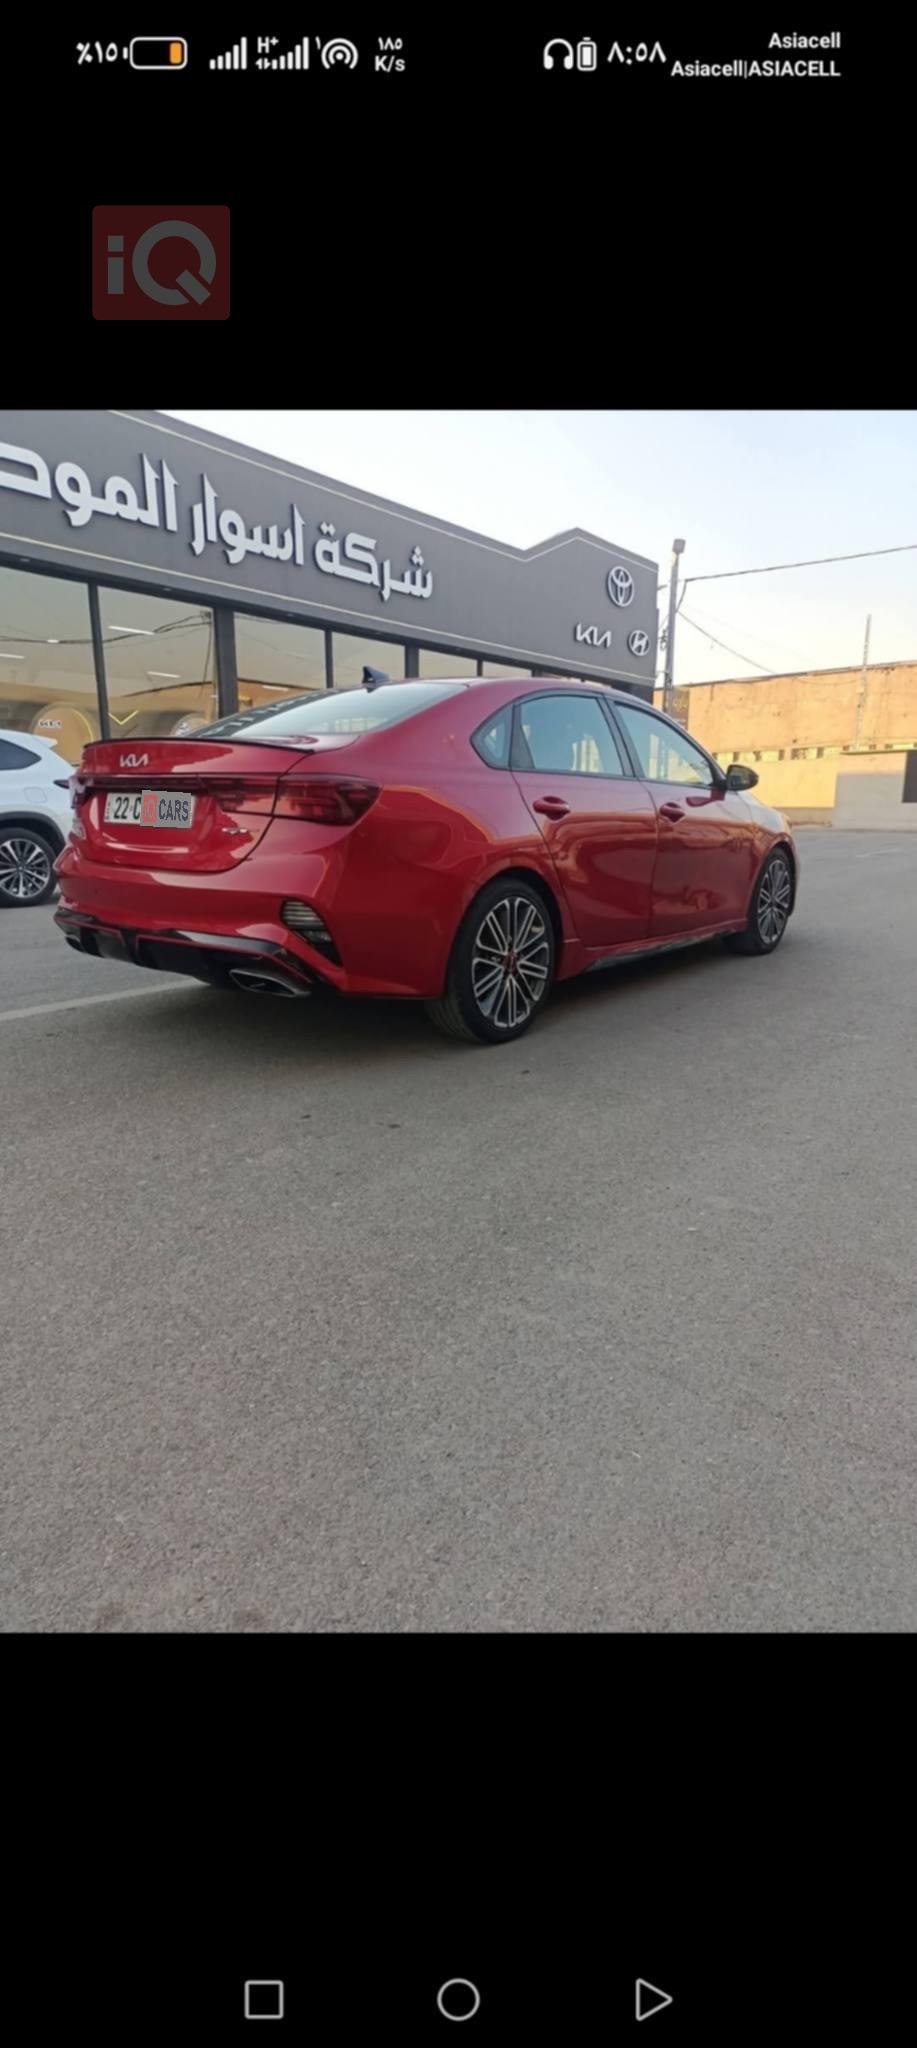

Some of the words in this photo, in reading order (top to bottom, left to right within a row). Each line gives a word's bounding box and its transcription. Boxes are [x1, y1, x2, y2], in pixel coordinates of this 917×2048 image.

[190, 472, 307, 565] اسوار
[314, 520, 434, 602] شركة
[576, 623, 611, 648] KIA
[119, 752, 149, 768] KIA
[113, 796, 130, 820] 22
